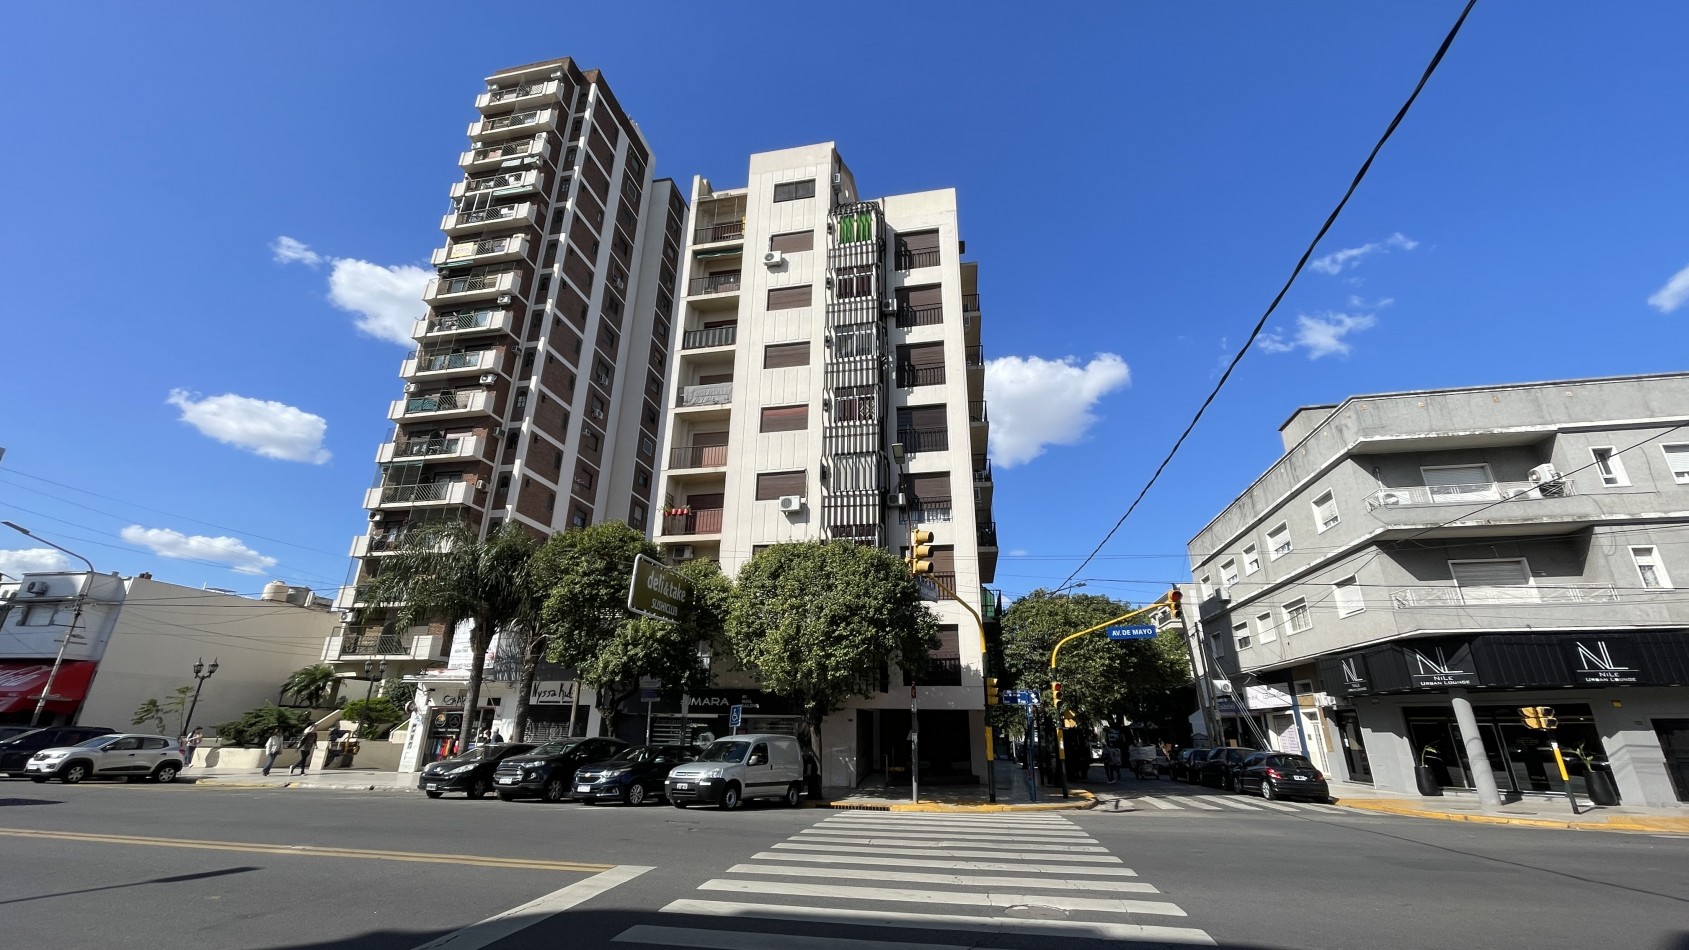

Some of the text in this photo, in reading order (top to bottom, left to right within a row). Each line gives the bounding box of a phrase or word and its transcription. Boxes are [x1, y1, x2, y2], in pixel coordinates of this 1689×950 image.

[647, 570, 686, 602] deli&take
[558, 682, 575, 700] Kid
[680, 697, 729, 706] MARA
